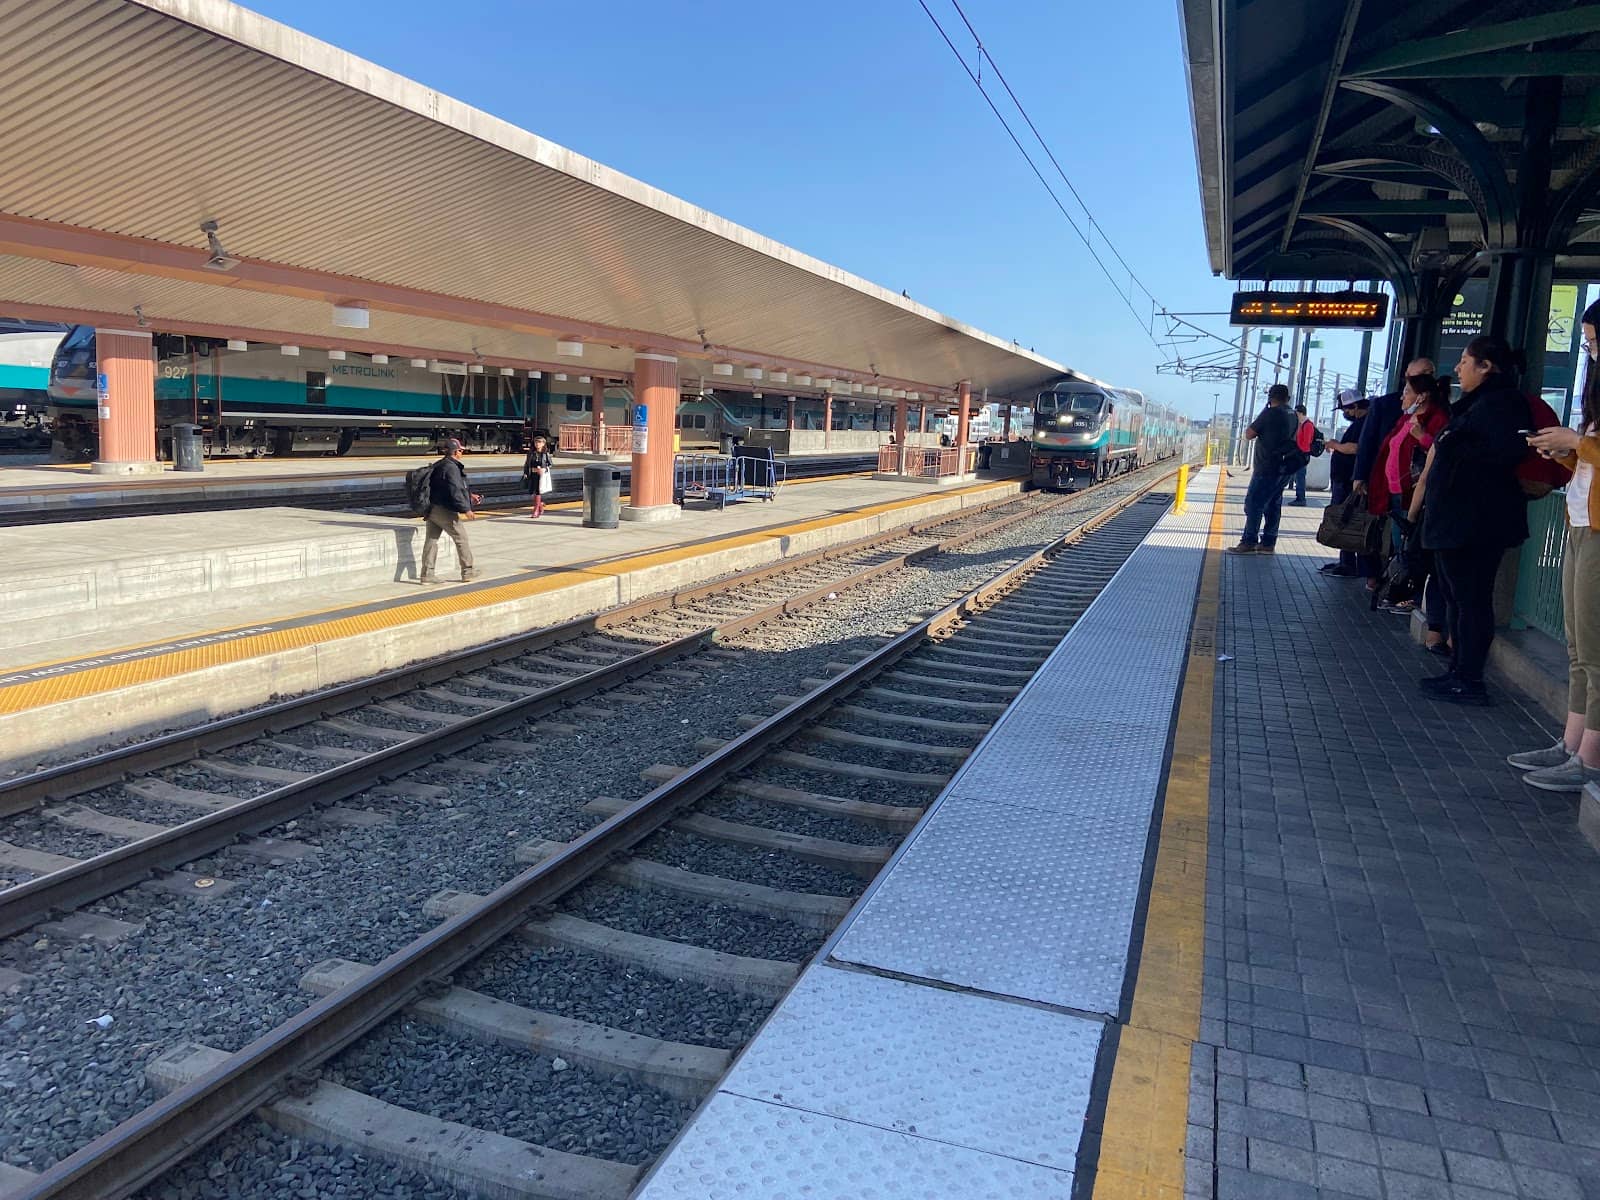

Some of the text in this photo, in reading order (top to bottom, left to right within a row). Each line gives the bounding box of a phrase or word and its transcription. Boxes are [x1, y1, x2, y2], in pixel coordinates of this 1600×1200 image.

[164, 366, 188, 379] 927
[332, 362, 396, 378] METROLINK
[175, 637, 217, 648] WAIT
[110, 645, 176, 660] BEHIND
[30, 658, 111, 676] YELLOW
